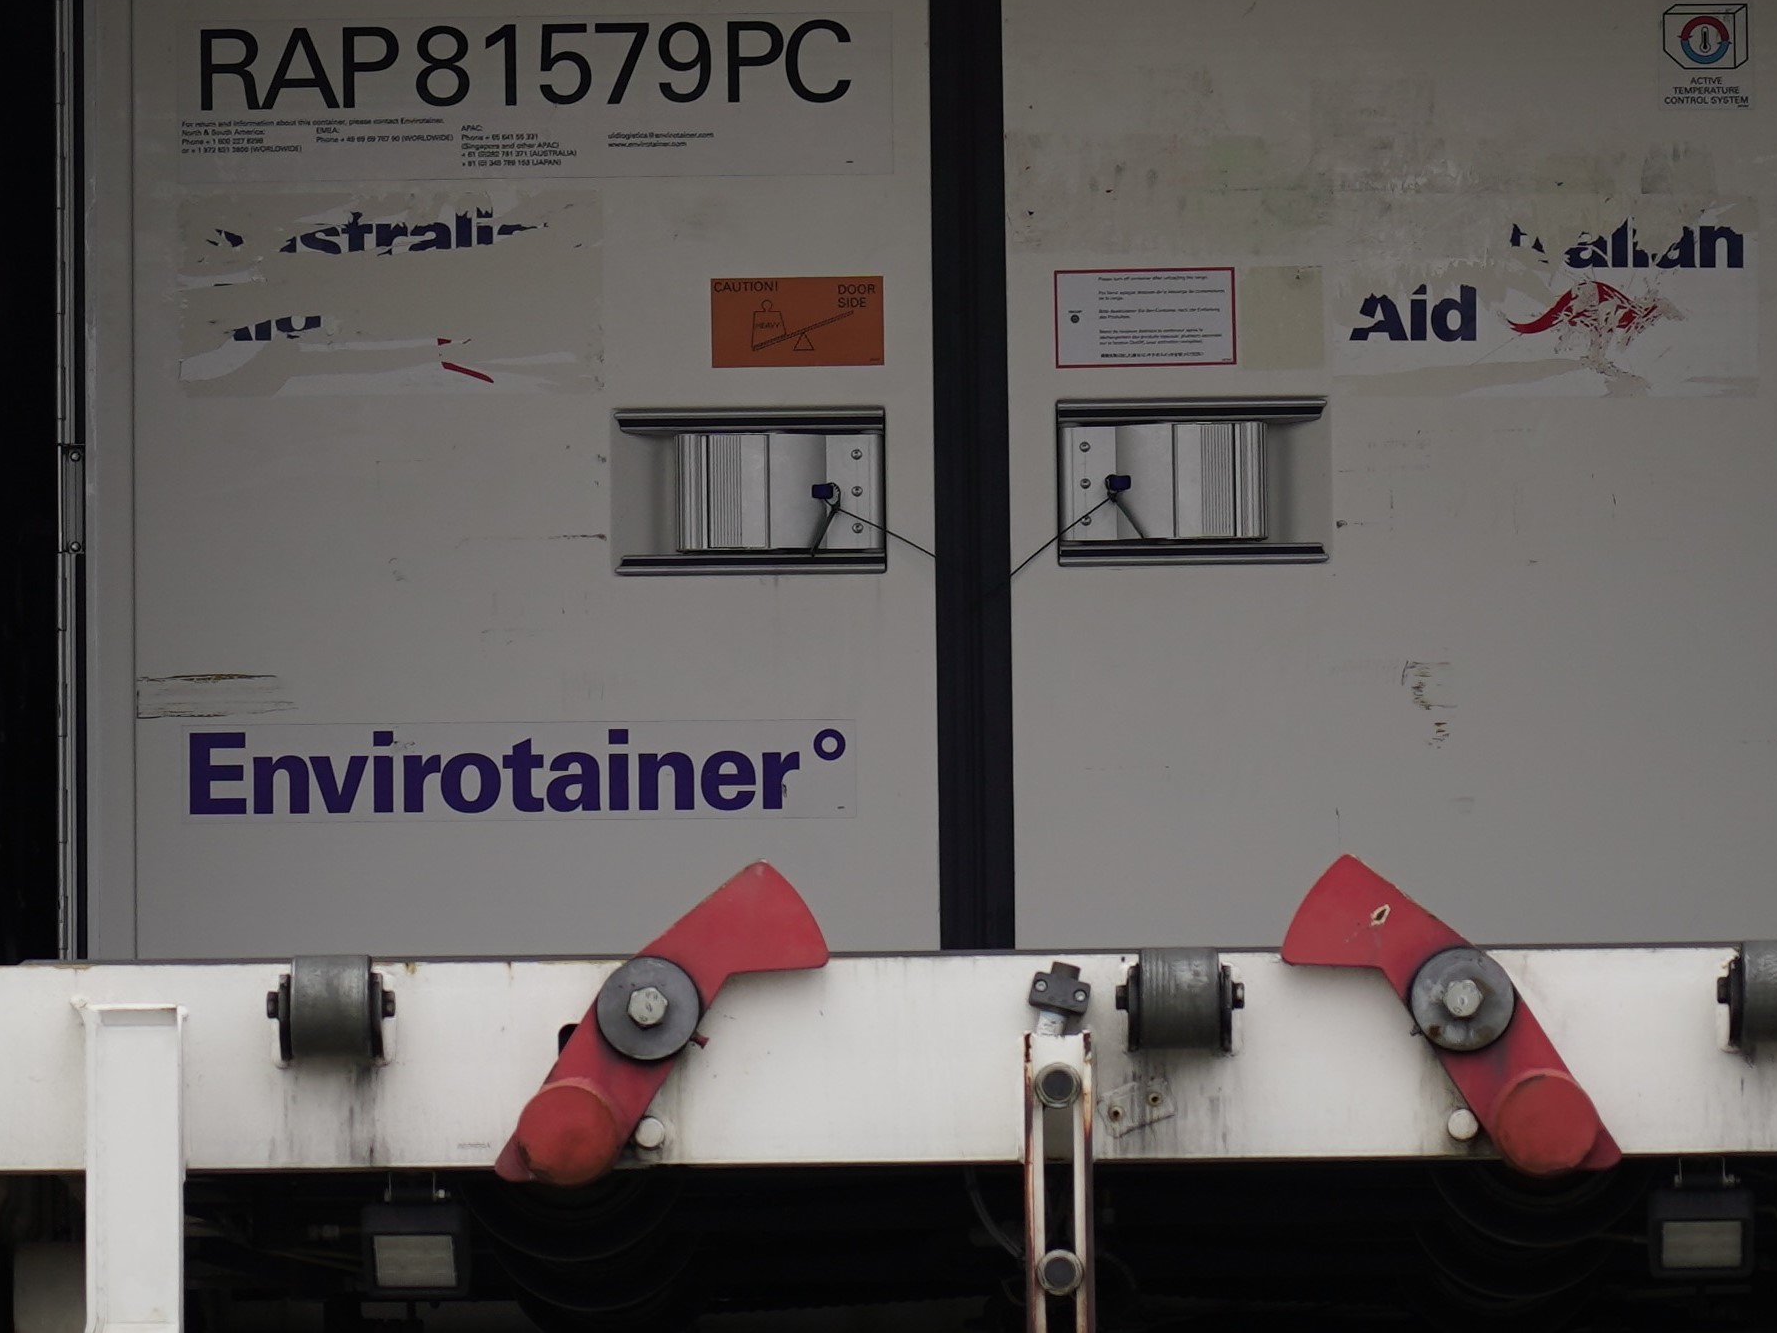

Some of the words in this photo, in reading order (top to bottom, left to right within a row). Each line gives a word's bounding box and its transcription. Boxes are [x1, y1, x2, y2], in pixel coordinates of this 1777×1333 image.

[198, 19, 853, 111] RAP81579PC
[1690, 76, 1723, 85] ACTIVE
[1673, 86, 1740, 95] TEMPERATURE
[1664, 96, 1709, 105] CONTROL
[1710, 96, 1749, 104] SYSTEM
[713, 280, 778, 293] CAUTION!
[837, 283, 876, 295] DOOR
[837, 297, 867, 309] SIDE
[1349, 283, 1477, 342] Aid
